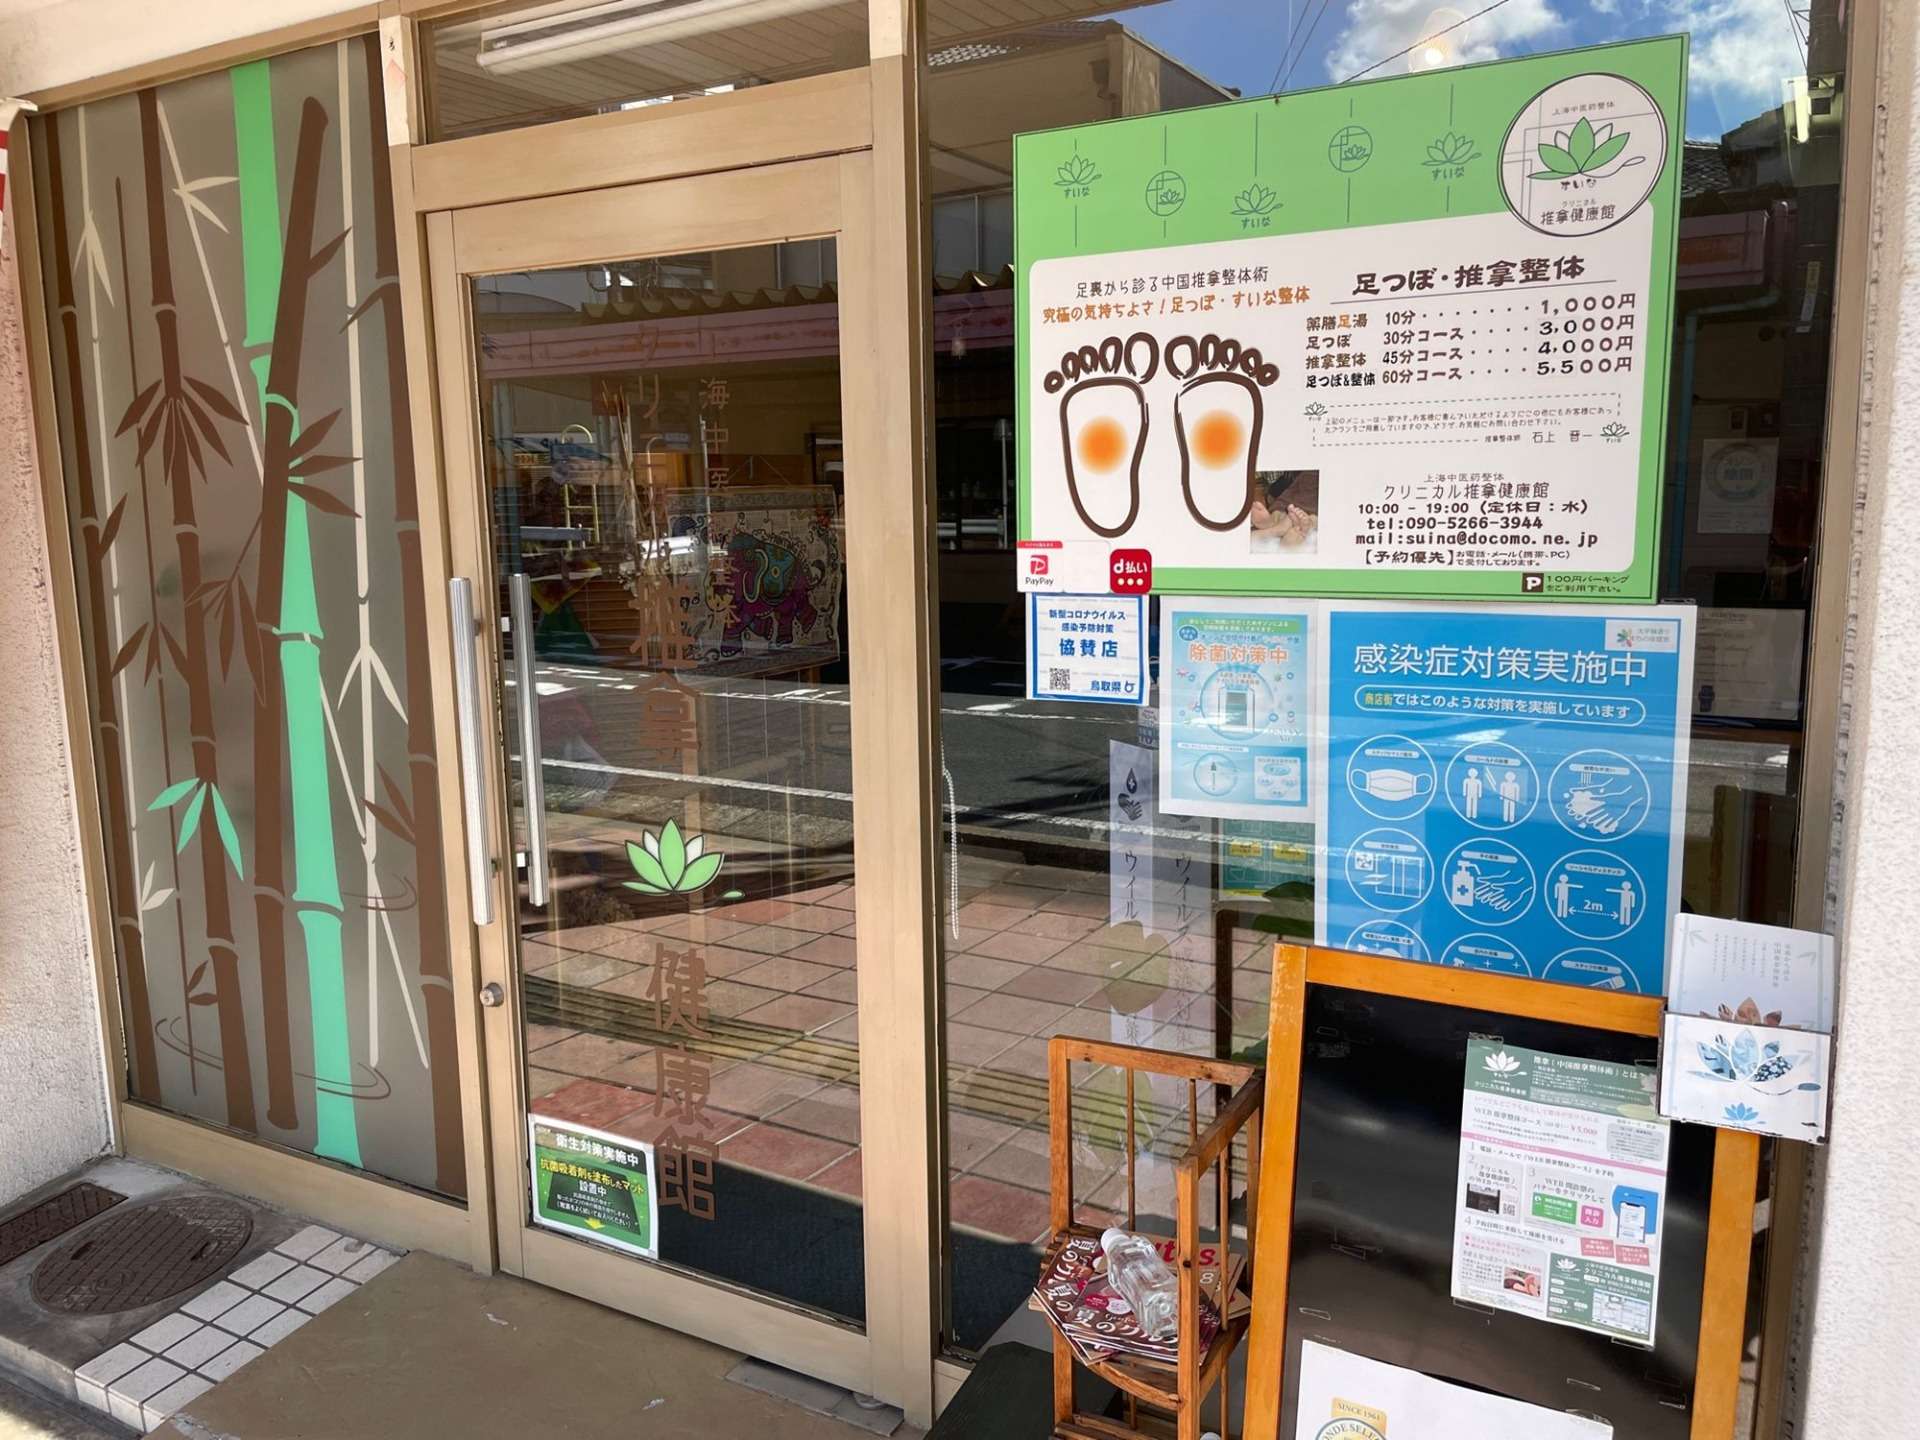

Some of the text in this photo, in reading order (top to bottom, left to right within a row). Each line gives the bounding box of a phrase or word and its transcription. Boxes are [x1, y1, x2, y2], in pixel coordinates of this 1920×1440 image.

[1064, 187, 1090, 198] すいな
[1241, 217, 1271, 229] すいな
[1540, 205, 1616, 226] 推拿健康館
[1076, 266, 1269, 299] 足裏から診る中国推拿整体術
[1352, 255, 1585, 295] 足つぼ・推拿整体
[1306, 313, 1368, 332] 薬膳足湯
[1541, 293, 1636, 316] 1,000円
[1305, 314, 1635, 350] 足つぼ 30分コース 3,000円
[1305, 335, 1633, 370] 推拿整体 45分コース 4,000円
[1305, 356, 1632, 389] 足つぼ&整体 60分コース 5,500円
[1532, 432, 1555, 444] 石上
[1383, 481, 1550, 500] クリニカル推拿健康館
[1358, 503, 1399, 515] 10:00
[1427, 502, 1469, 514] 19:00
[1367, 517, 1543, 530] tel:090-5266-3944
[1355, 532, 1598, 548] mail:suina@docomo.ne.jp
[1365, 550, 1454, 565] 【予約優先】
[1113, 559, 1147, 573] d払い
[1025, 577, 1054, 586] PayPay
[1526, 576, 1540, 590] P
[1049, 609, 1126, 620] 新型コロナウイルス
[1061, 622, 1114, 633] 感染予防対策
[1059, 638, 1118, 657] 協賛店
[1189, 643, 1288, 664] 除菌対策中
[1354, 643, 1647, 687] 感染症対策実施中
[1091, 680, 1121, 691] 鳥取県
[1365, 693, 1630, 719] 商店街ではこのような対策を実施しています
[1584, 900, 1603, 911] 2m
[646, 942, 719, 1221] 健康館
[556, 1134, 639, 1167] 衛生対策実施中
[579, 1180, 607, 1197] 設置中
[1337, 1402, 1361, 1415] SINCE
